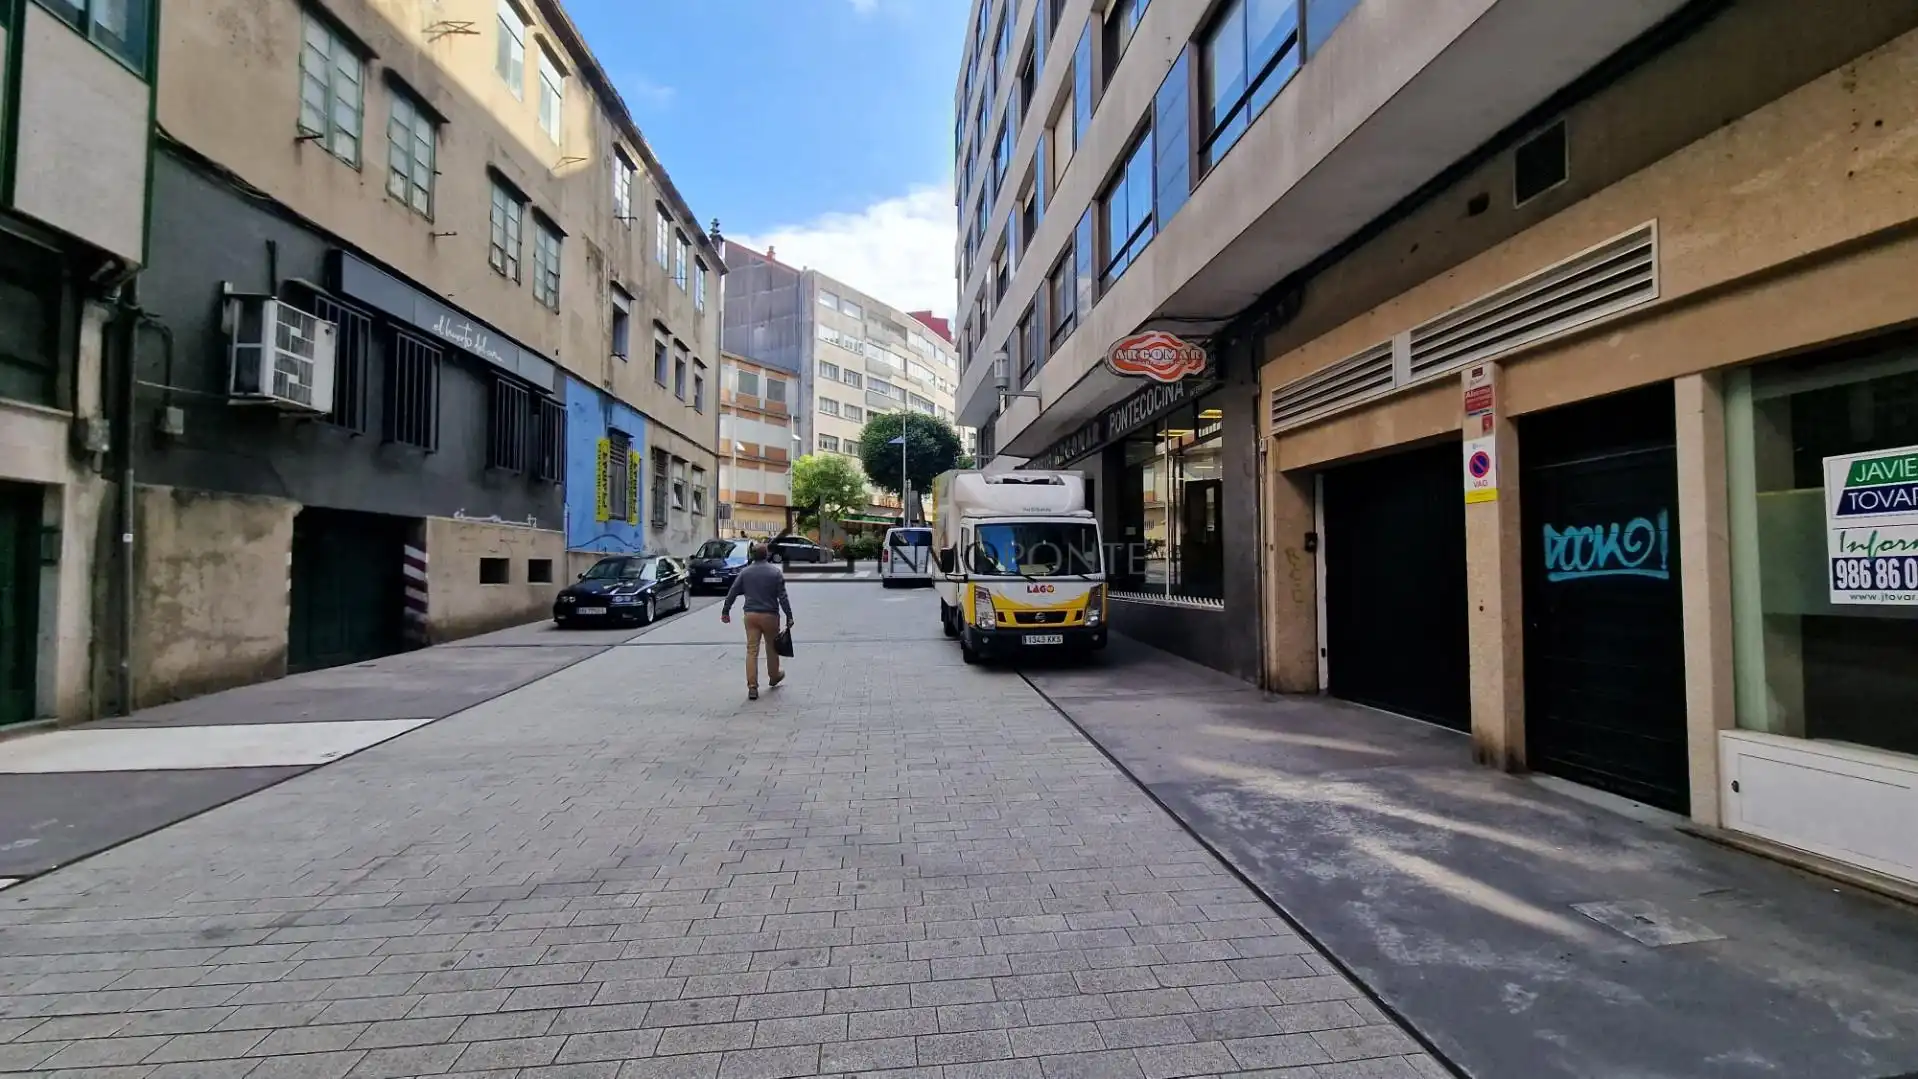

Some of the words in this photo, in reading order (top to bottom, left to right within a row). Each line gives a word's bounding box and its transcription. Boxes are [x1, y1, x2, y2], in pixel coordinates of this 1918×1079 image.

[1109, 381, 1185, 437] PONTECOCINA
[1027, 585, 1055, 594] LAGO
[1836, 558, 1872, 590] 986
[1875, 558, 1901, 589] 86
